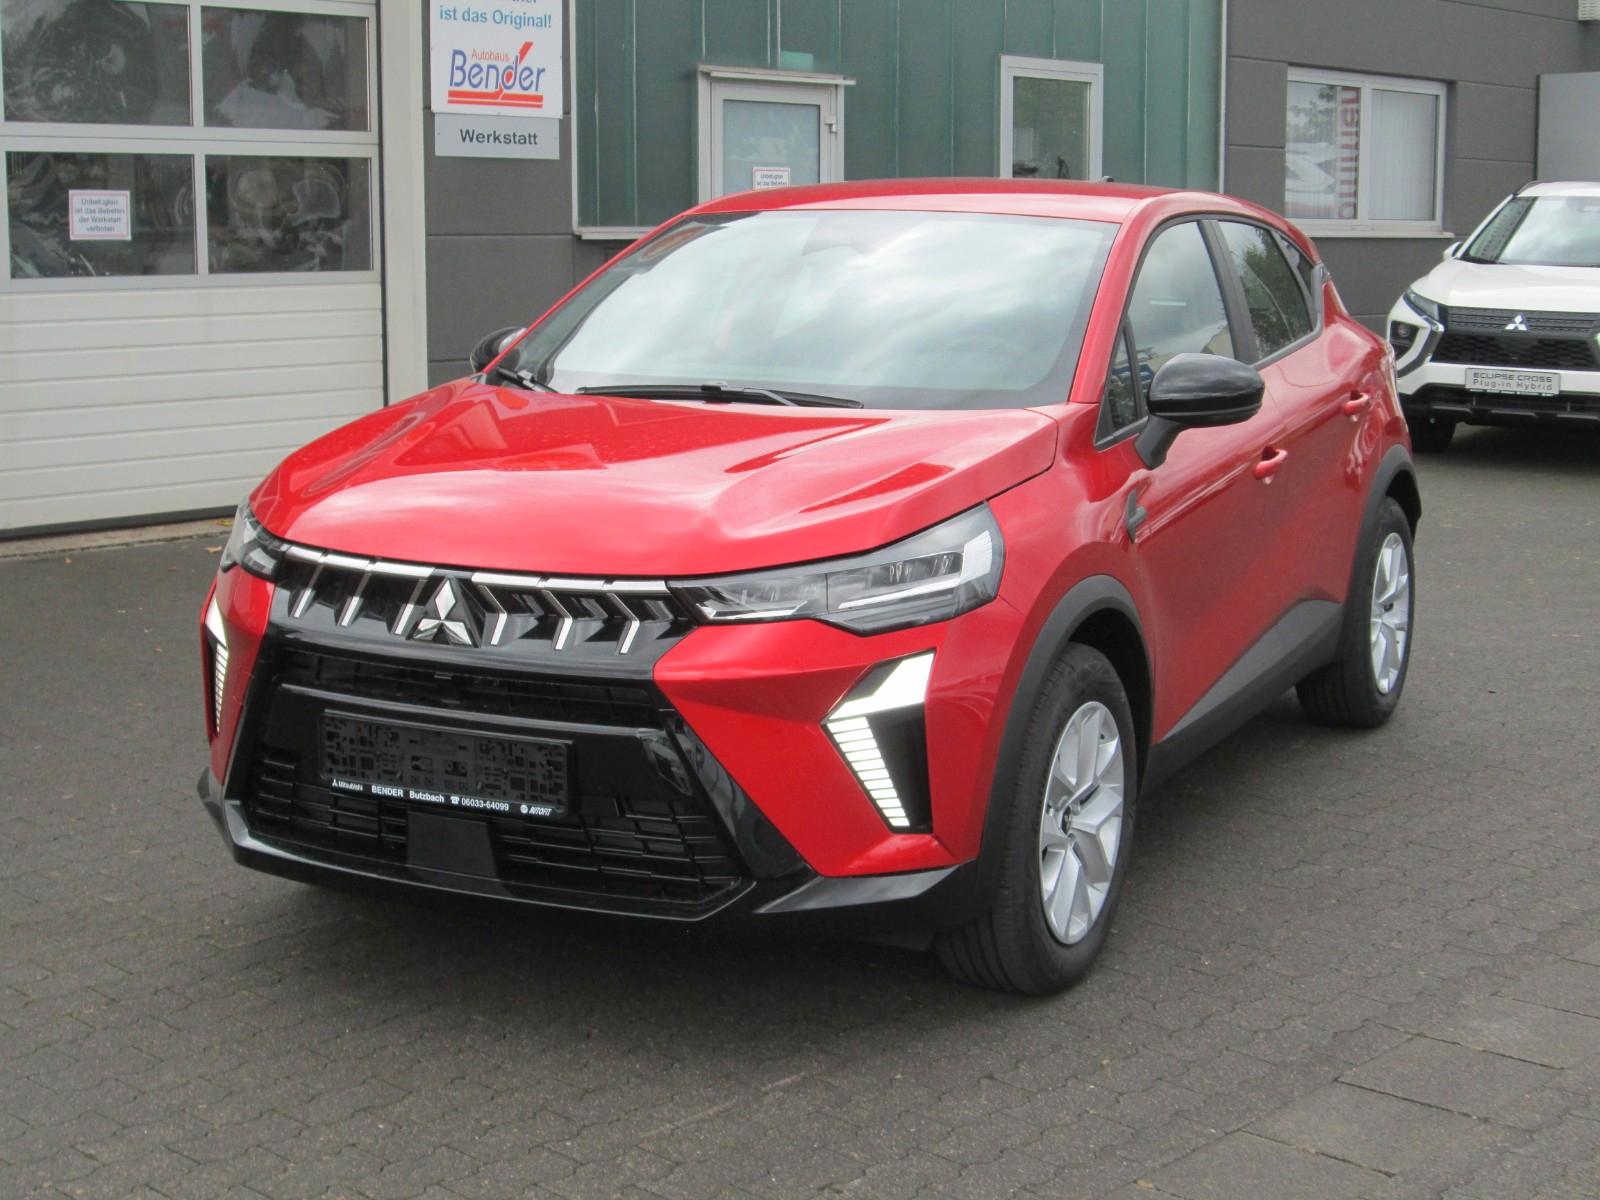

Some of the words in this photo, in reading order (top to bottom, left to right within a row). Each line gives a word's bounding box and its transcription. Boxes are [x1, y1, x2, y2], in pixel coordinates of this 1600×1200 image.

[440, 5, 457, 21] ist
[462, 8, 488, 23] das
[492, 9, 552, 30] Original!
[471, 49, 510, 62] Autohaus
[450, 47, 546, 92] Bender
[460, 128, 538, 145] Werkstatt
[1473, 372, 1514, 380] ECLIPSE
[1473, 379, 1512, 388] Plug-in
[1516, 382, 1552, 391] Hybrid
[371, 785, 404, 798] BENDER
[409, 790, 445, 803] Butzbach
[461, 797, 509, 812] 06033-64099
